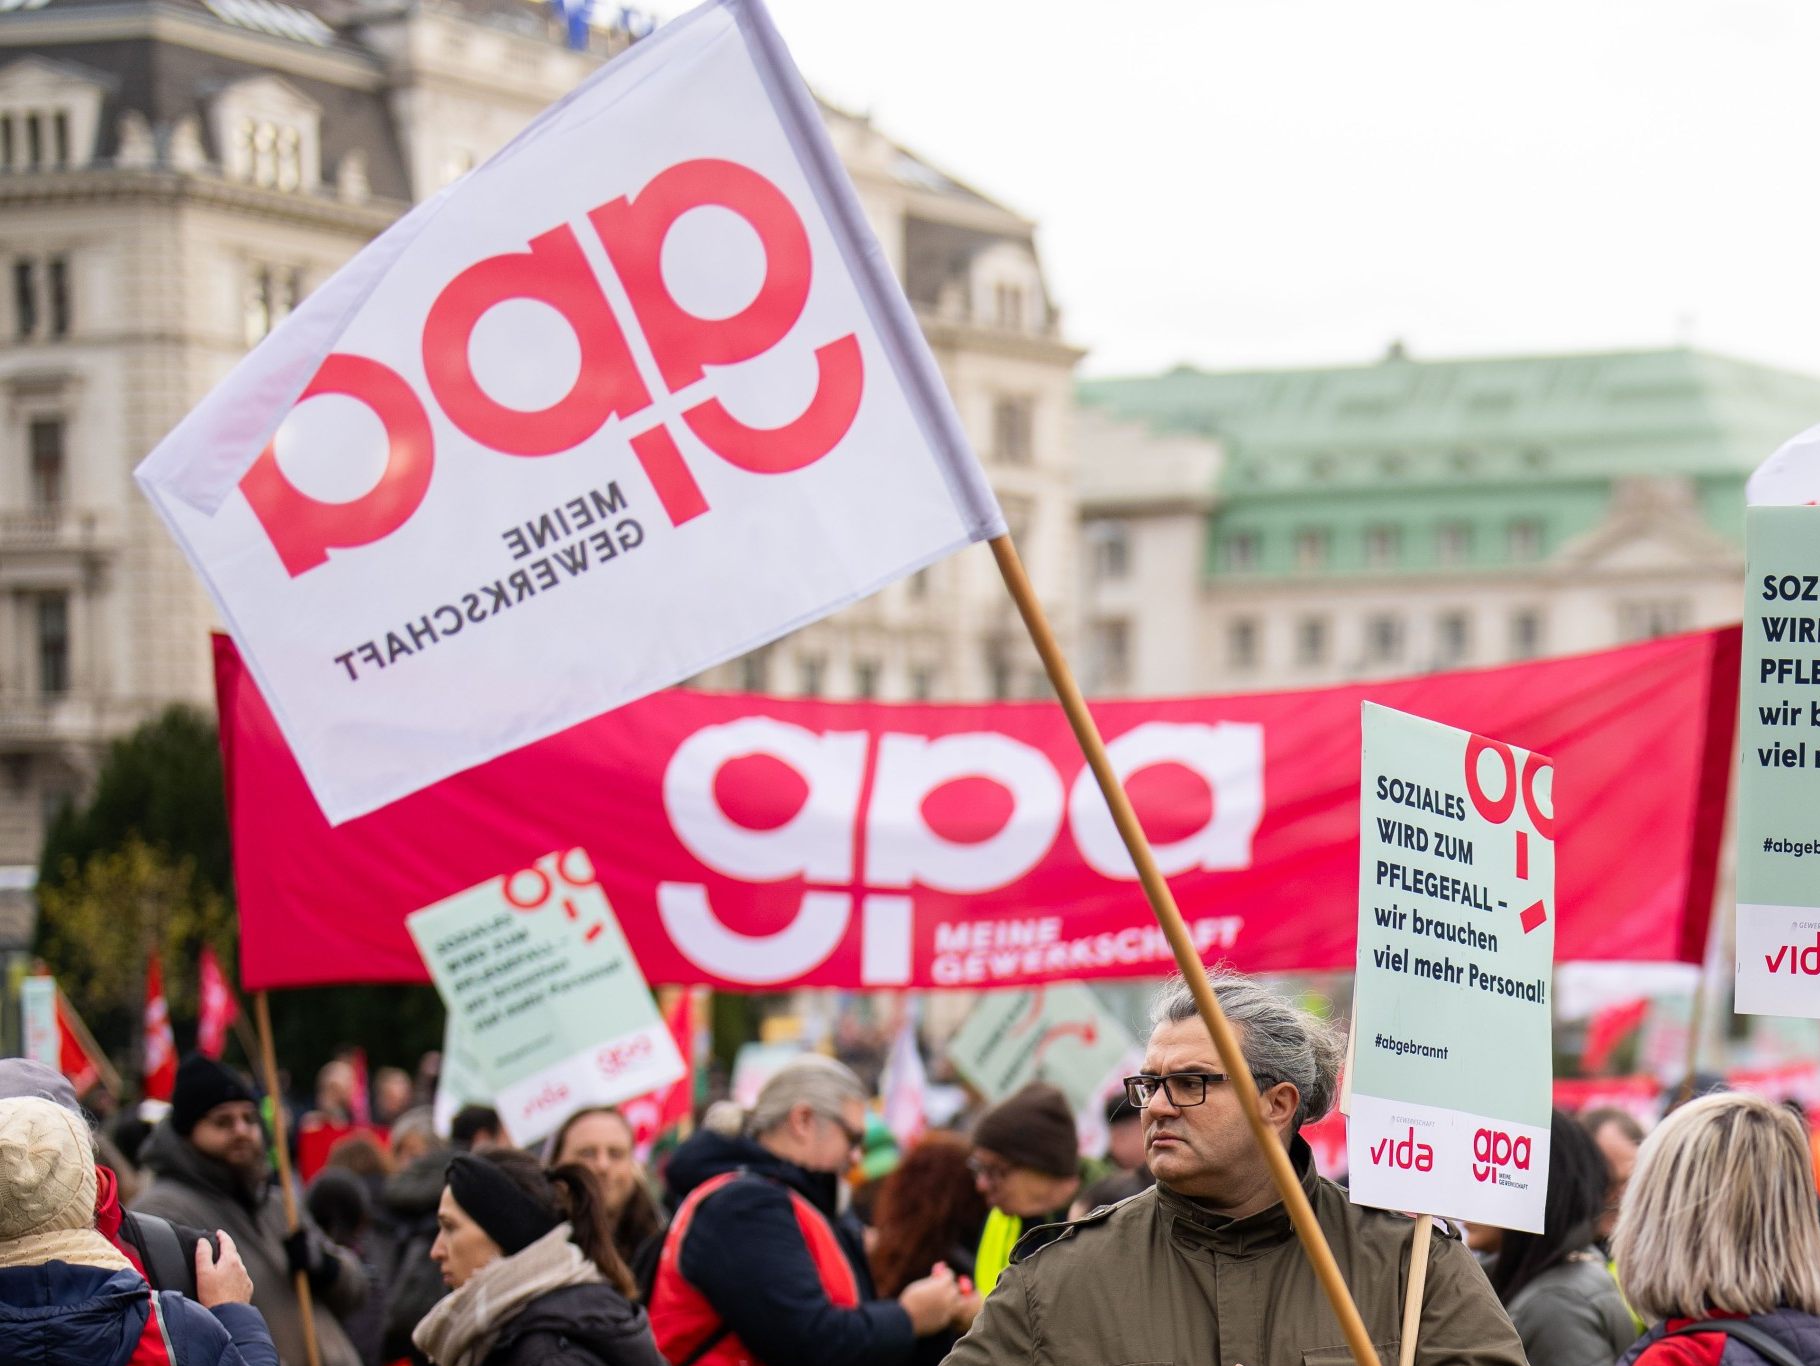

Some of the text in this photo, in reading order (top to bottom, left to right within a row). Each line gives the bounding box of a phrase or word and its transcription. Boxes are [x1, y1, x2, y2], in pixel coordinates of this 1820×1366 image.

[1758, 700, 1803, 727] wir
[1757, 742, 1806, 769] viel
[1375, 774, 1466, 822] SOZIALES
[656, 715, 1264, 987] gpa
[1375, 816, 1474, 866] WIRD ZUM
[1375, 859, 1493, 913] PFLEGEFALL
[931, 915, 1245, 986] GEWERKSCHFT
[934, 916, 1062, 954] MEINE
[1374, 903, 1498, 953] wir brauchen
[1373, 944, 1546, 1005] viel mehr Personal!
[1374, 1032, 1449, 1060] #abgebrannt
[1370, 1126, 1532, 1184] vida gpa
